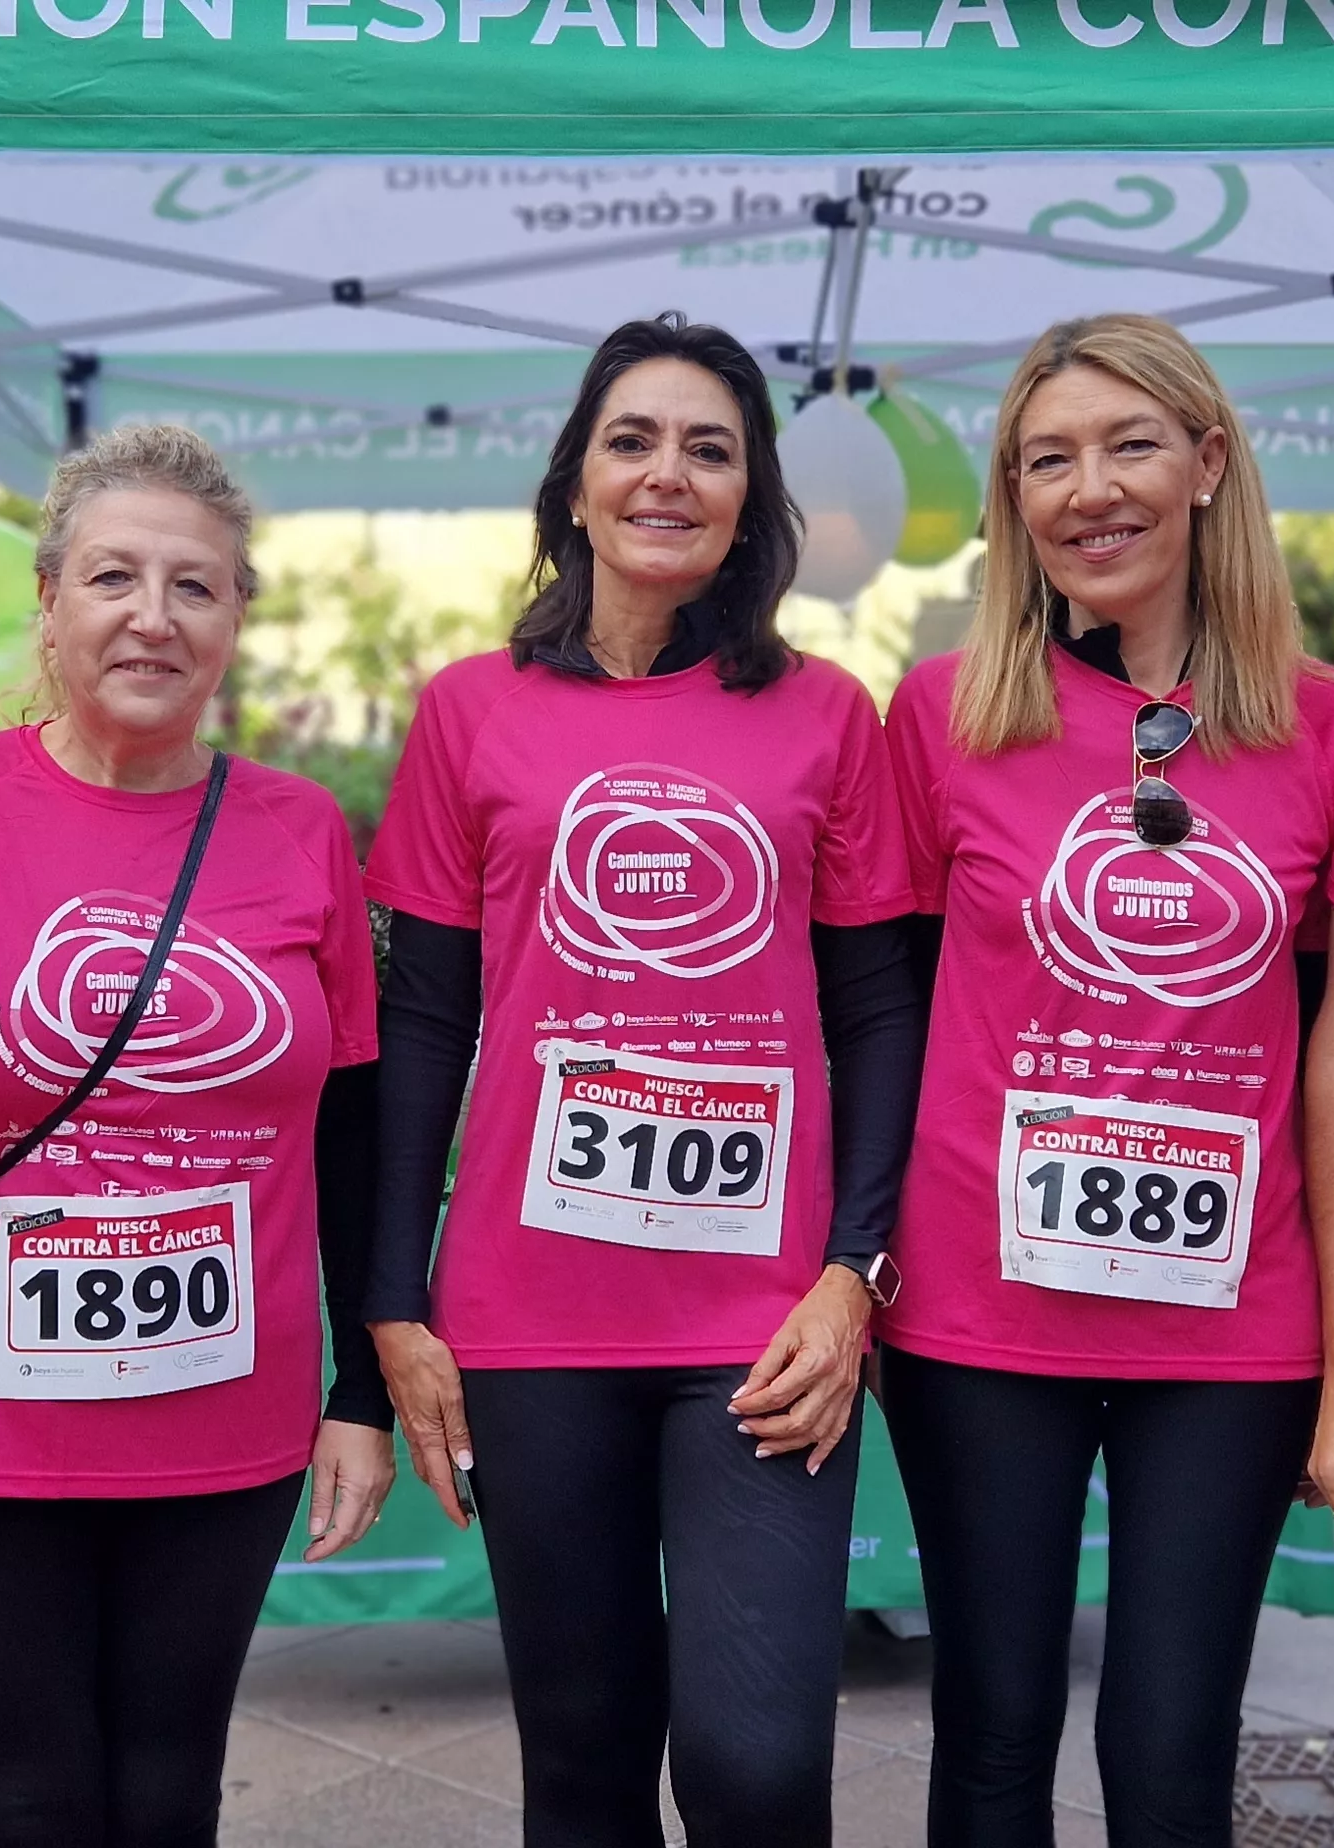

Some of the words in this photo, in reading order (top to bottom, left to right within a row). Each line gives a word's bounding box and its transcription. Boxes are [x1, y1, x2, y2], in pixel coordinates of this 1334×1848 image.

[603, 780, 612, 789] X
[610, 788, 650, 798] CONTRA
[652, 790, 664, 799] EL
[607, 851, 692, 870] Caminemos
[614, 871, 687, 894] JUNTOS
[1107, 875, 1194, 898] Caminemos
[1112, 896, 1189, 921] JUNTOS
[87, 915, 128, 925] CONTRA
[130, 919, 143, 927] EL
[85, 970, 172, 993] Camines
[596, 965, 607, 980] Te
[607, 968, 636, 983] apoyo
[91, 992, 167, 1016] JUNS
[1087, 984, 1099, 998] Te
[1098, 988, 1128, 1006] apoyo
[681, 1009, 717, 1028] vive
[729, 1013, 769, 1023] URBAN
[620, 1041, 662, 1052] Alcampo
[714, 1039, 752, 1050] Humeco
[1169, 1040, 1202, 1056] vive
[572, 1061, 609, 1074] DICIÓN
[643, 1078, 704, 1098] HUESCA
[574, 1080, 657, 1112] CONTRA
[662, 1097, 685, 1116] EL
[690, 1097, 767, 1120] CÁNCER
[1022, 1116, 1030, 1126] X
[1030, 1109, 1067, 1124] EDICIÓN
[159, 1124, 197, 1143] vive
[210, 1130, 252, 1139] URBAN
[1105, 1121, 1166, 1142] HUESCA
[91, 1150, 136, 1163] Alcampo
[193, 1155, 231, 1167] Humeco
[557, 1110, 765, 1198] 3109
[1032, 1130, 1118, 1156] CONTRA
[1124, 1143, 1147, 1159] EL
[1152, 1142, 1232, 1171] CÁNCER
[1026, 1160, 1228, 1250] 1889
[11, 1222, 19, 1233] X
[18, 1212, 57, 1232] EDICIÓN
[96, 1219, 161, 1236] HUESCA
[22, 1236, 113, 1256] CONTRA
[118, 1237, 143, 1256] EL
[148, 1224, 223, 1253] CÁNCER
[19, 1256, 231, 1342] 1890
